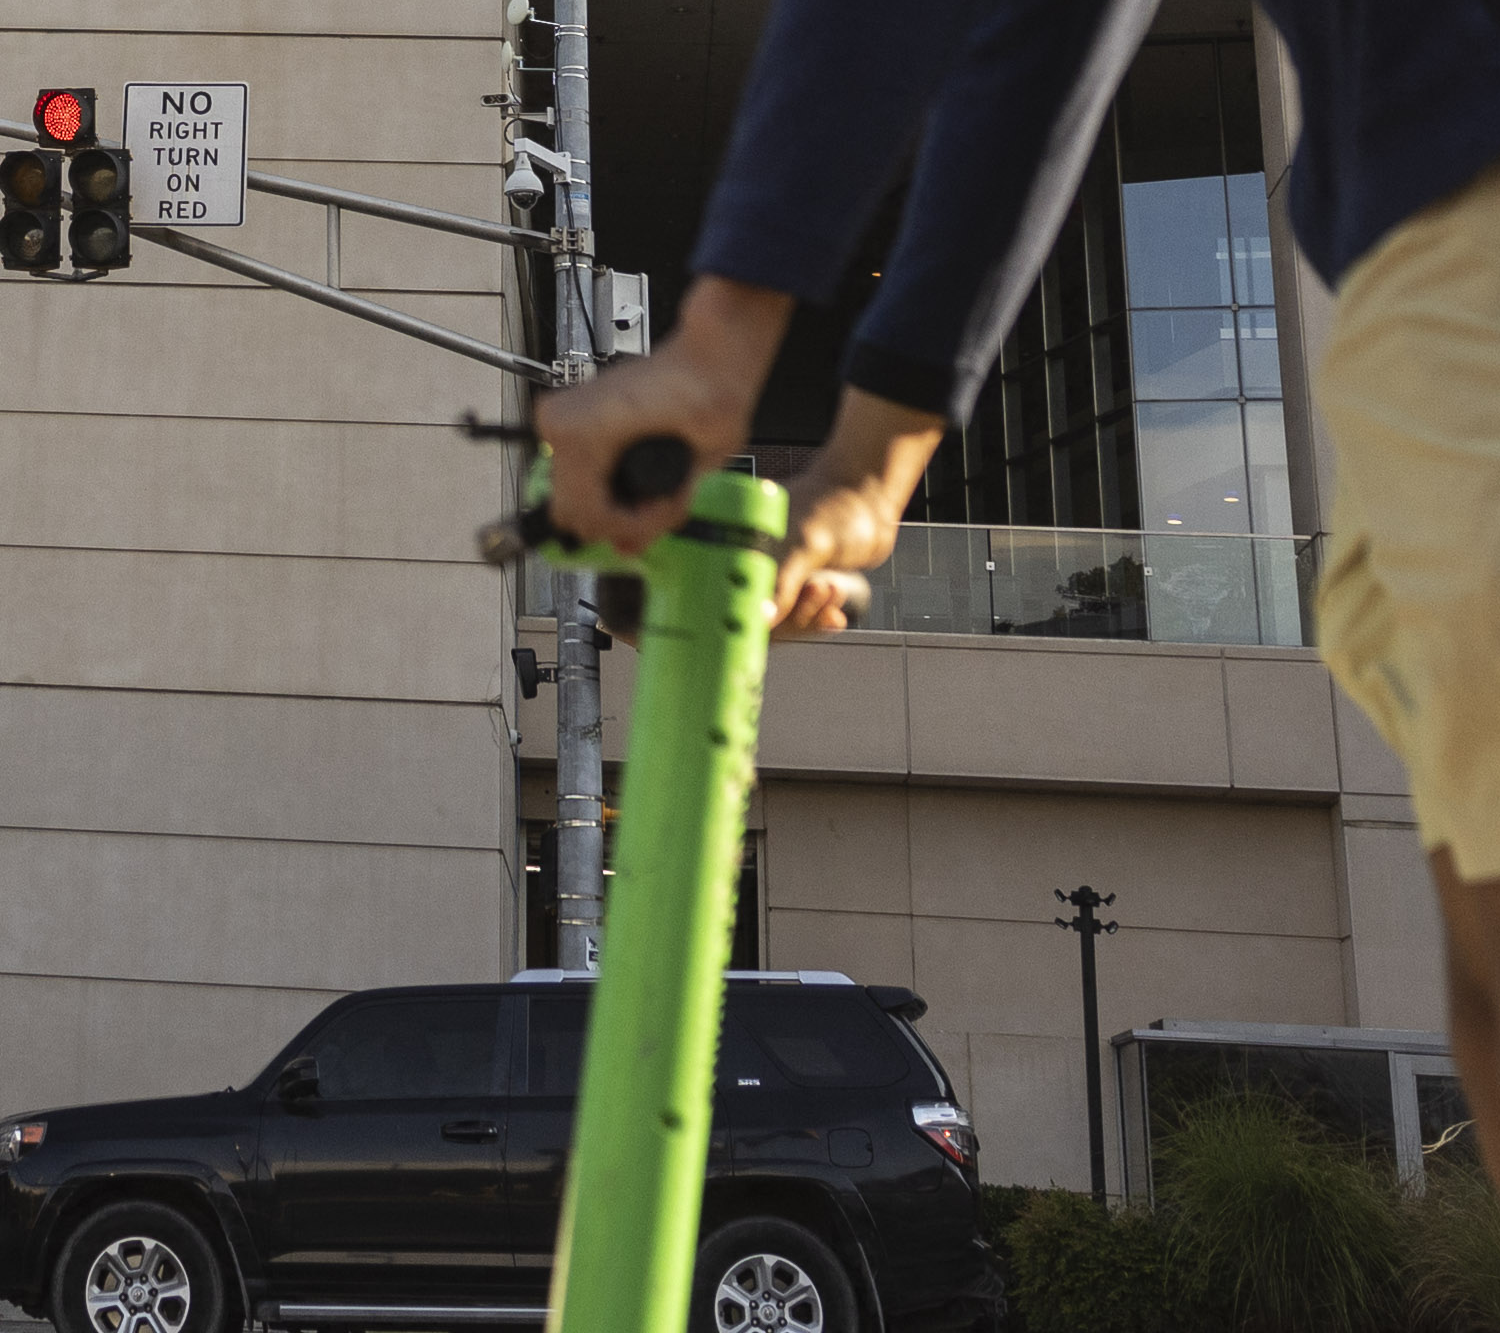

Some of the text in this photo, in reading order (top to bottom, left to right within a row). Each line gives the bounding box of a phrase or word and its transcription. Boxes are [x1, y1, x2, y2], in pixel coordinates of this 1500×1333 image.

[162, 91, 213, 115] NO
[149, 121, 223, 140] RIGHT
[153, 147, 219, 166] TURN
[167, 173, 200, 192] ON
[158, 200, 207, 219] RED
